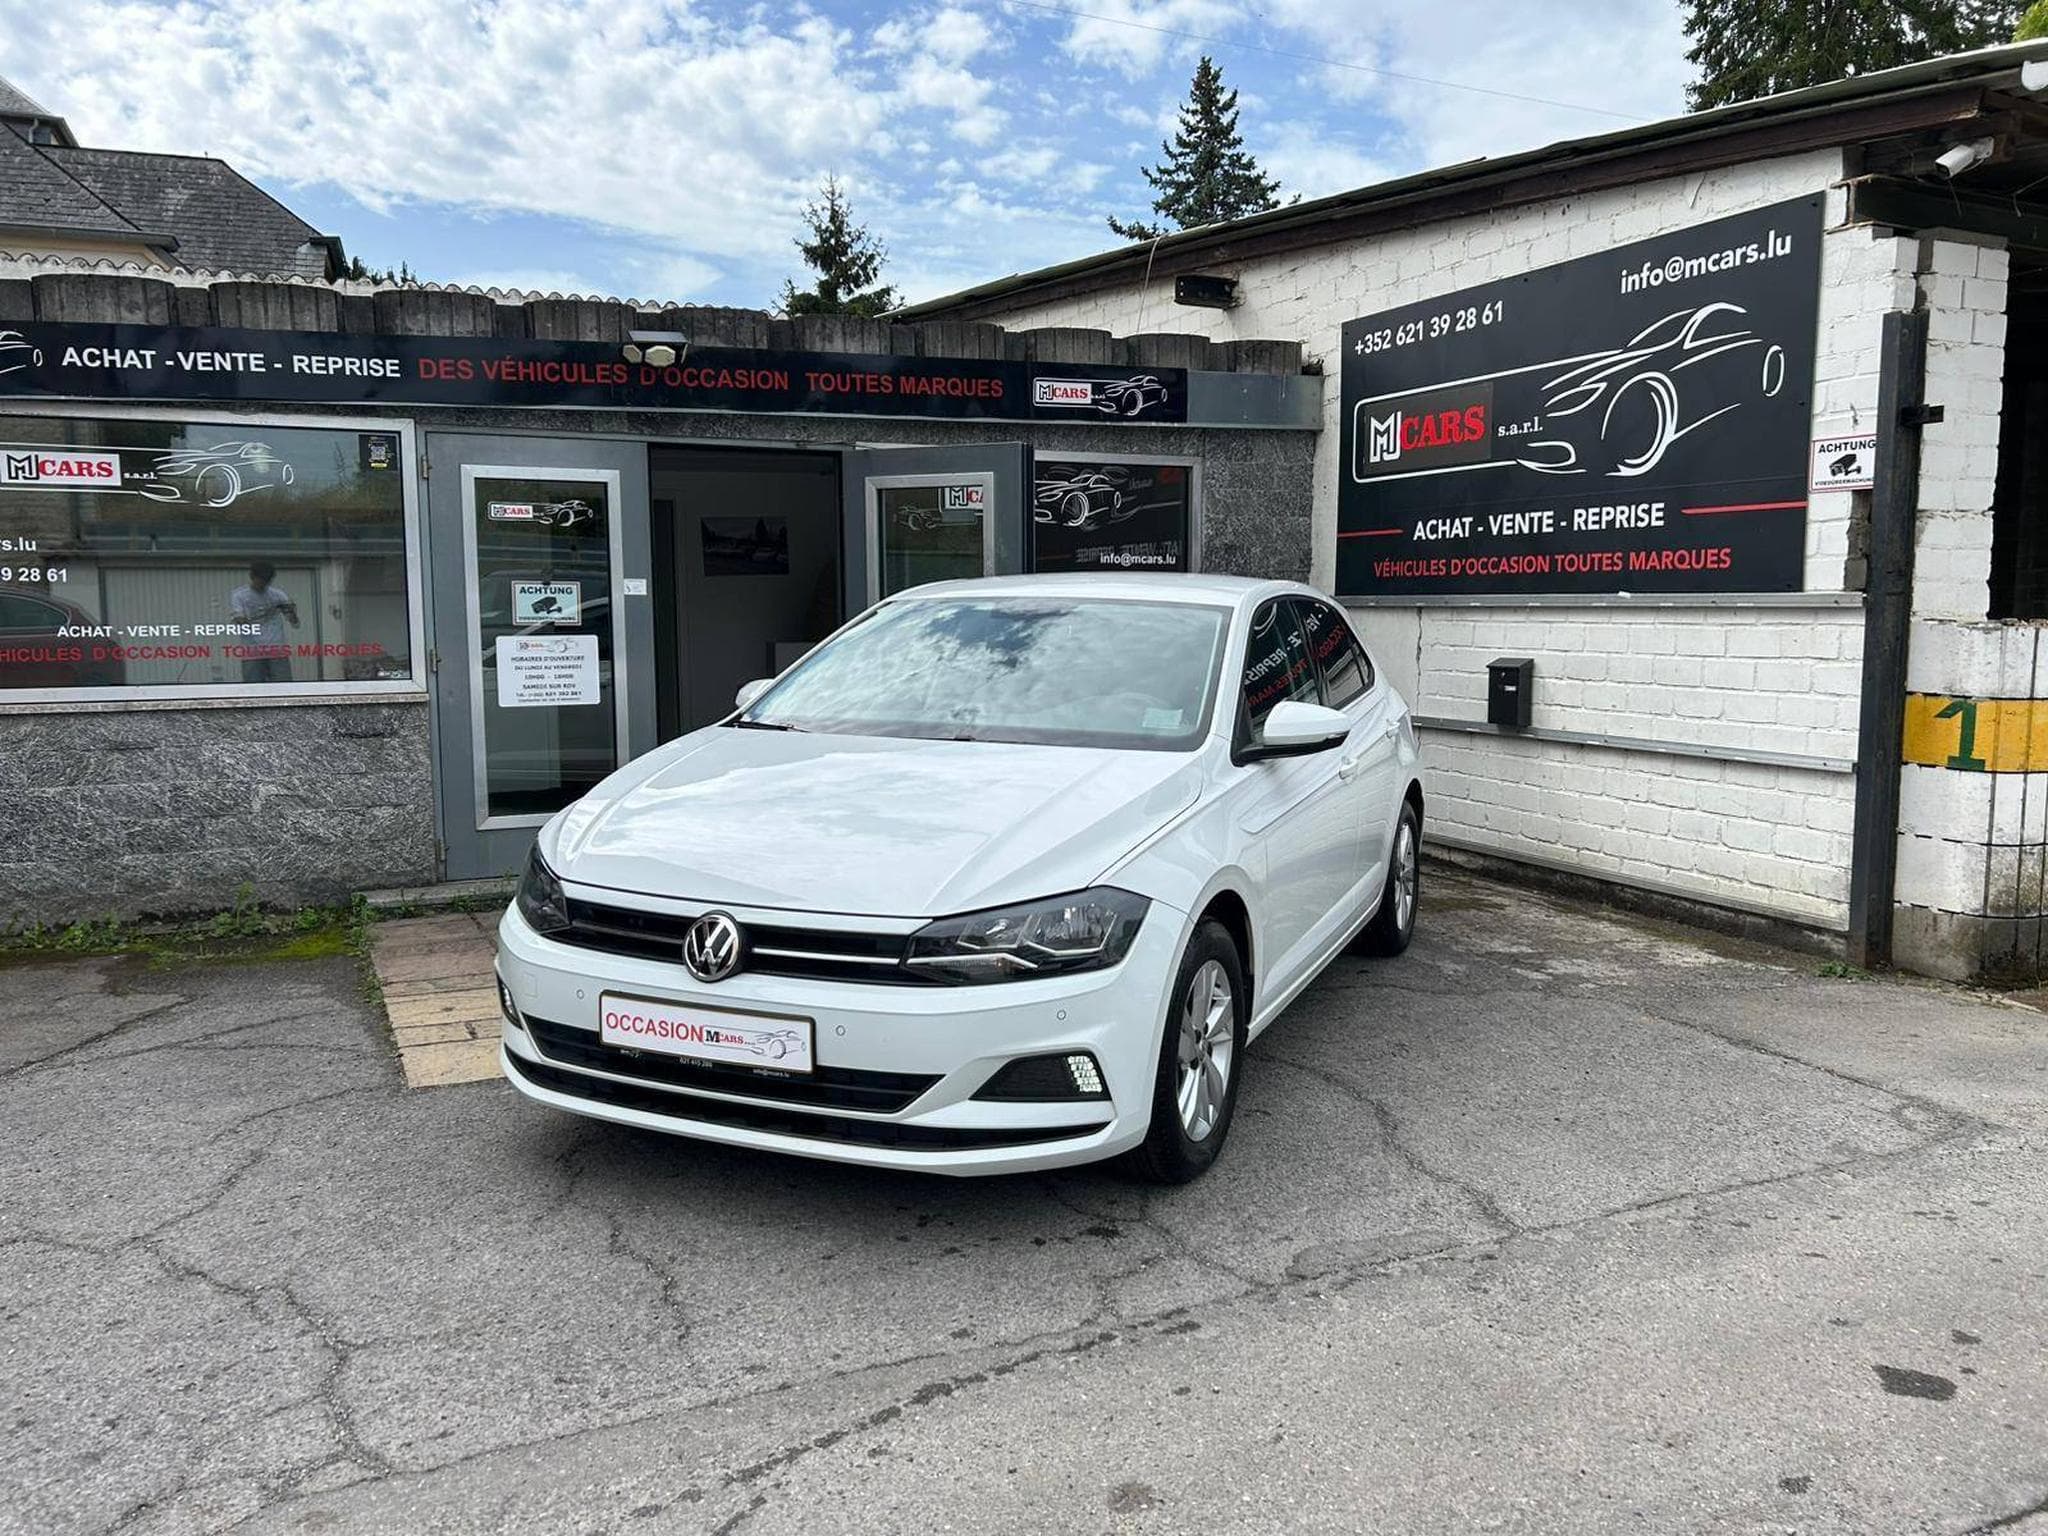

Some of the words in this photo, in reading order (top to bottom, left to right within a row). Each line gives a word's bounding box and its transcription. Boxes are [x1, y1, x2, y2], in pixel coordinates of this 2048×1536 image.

[1621, 230, 1792, 294] info@mcars.lu
[1355, 329, 1391, 355] +352
[1396, 320, 1424, 345] 621
[1430, 314, 1450, 338] 39
[1455, 307, 1477, 332] 28
[1482, 300, 1503, 325] 61
[62, 347, 156, 369] ACHAT
[293, 356, 400, 378] REPRISE
[419, 358, 474, 380] DES
[481, 356, 628, 384] VÉHICULES
[640, 366, 789, 390] D'OCCASION
[805, 371, 893, 395] TOUTES
[900, 375, 1004, 398] MARQUES
[1498, 416, 1543, 437] s.a.r.l.
[1818, 439, 1876, 453] ACHTUNG
[1413, 517, 1473, 541] ACHAT
[1488, 510, 1554, 536] VENTE
[1573, 502, 1665, 531] REPRISE
[1100, 552, 1176, 567] info@mcars.lu
[1374, 558, 1447, 578] VÉHICULES
[1555, 552, 1623, 573] TOUTES
[1629, 548, 1732, 571] MARQUES
[18, 567, 41, 582] 28
[46, 568, 67, 583] 61
[519, 586, 573, 595] ACHTUNG
[57, 625, 113, 638] ACHAT
[127, 625, 180, 637] VENTE
[194, 623, 262, 636] REPRISE
[93, 645, 211, 661] D'OCCASION
[223, 645, 292, 659] TOUTES
[297, 642, 384, 657] MARQUES
[1934, 699, 1985, 772] 1
[606, 1012, 704, 1043] OCCASION
